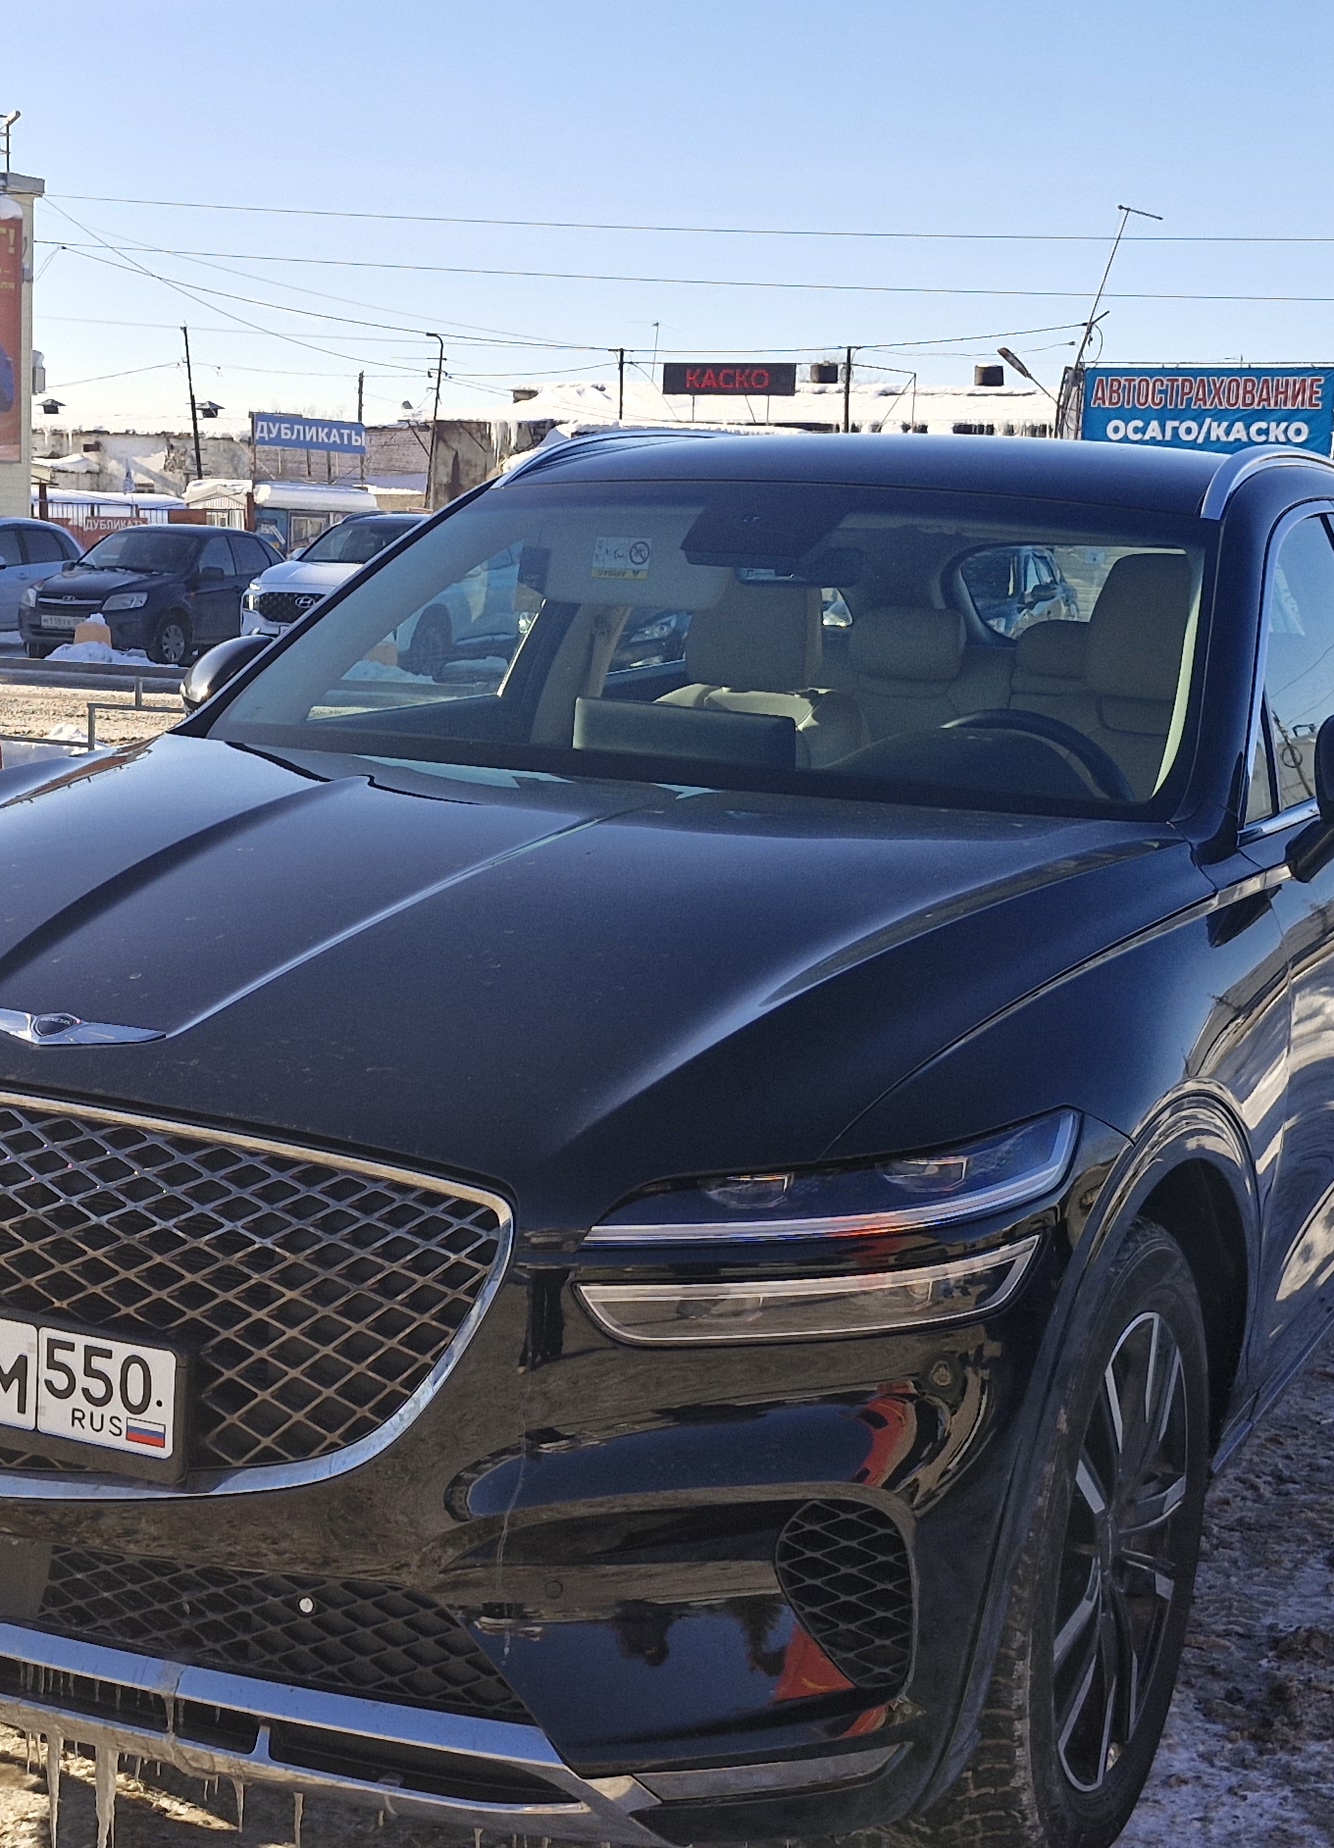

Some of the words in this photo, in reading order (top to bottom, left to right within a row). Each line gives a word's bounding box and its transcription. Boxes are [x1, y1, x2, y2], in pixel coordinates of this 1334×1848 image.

[685, 367, 771, 390] КАСКО
[1090, 375, 1325, 411] АВТОСТРАХОВАНИЕ
[255, 420, 366, 448] ДУБЛИКАТЫ
[1105, 416, 1310, 444] ОСАГО/КАСКО
[43, 1335, 154, 1416] 550
[69, 1407, 124, 1438] RUS
